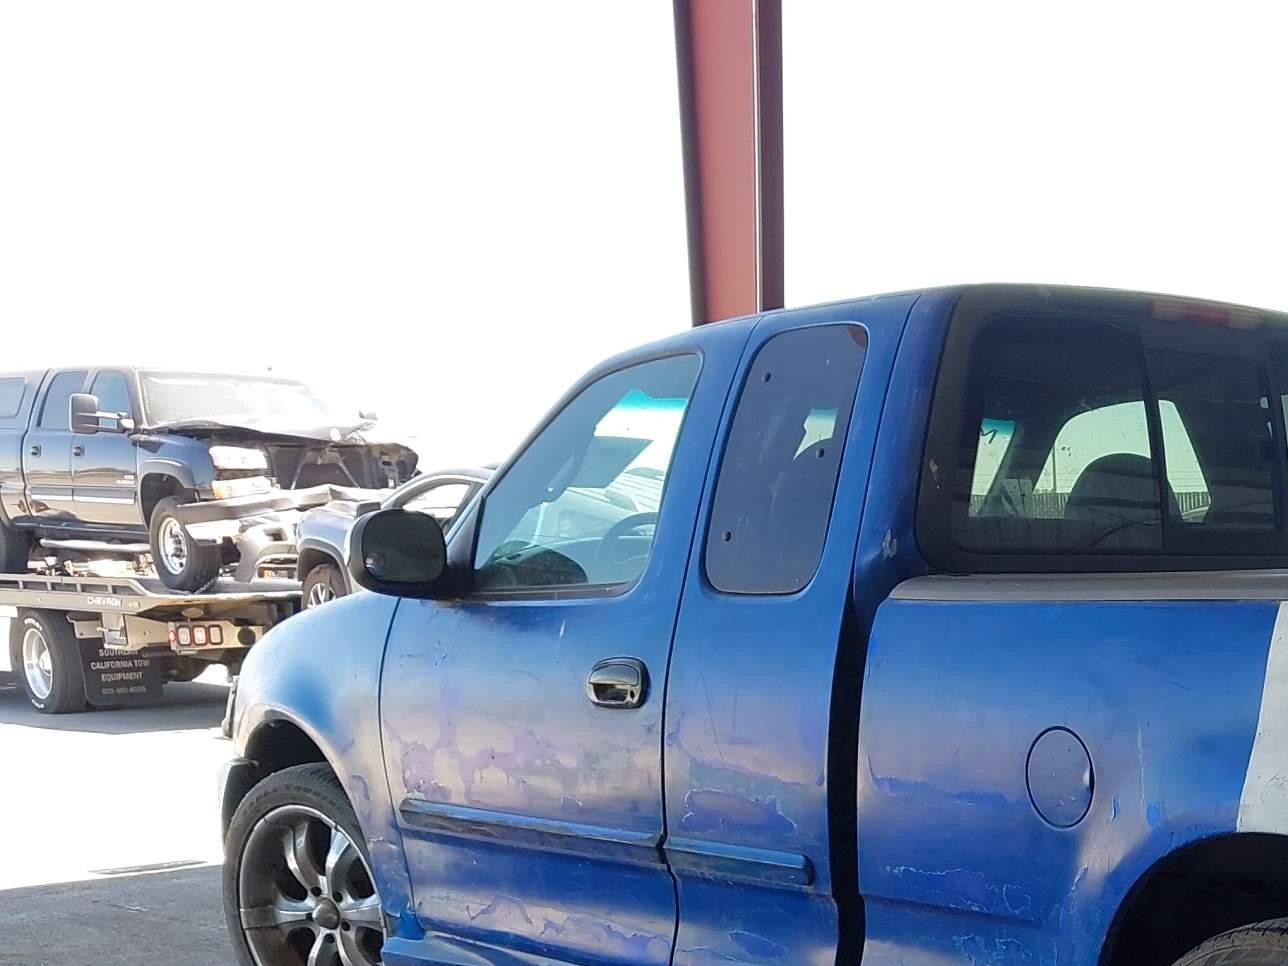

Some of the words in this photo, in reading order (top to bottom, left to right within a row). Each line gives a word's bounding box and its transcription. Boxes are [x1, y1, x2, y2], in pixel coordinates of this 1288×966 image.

[87, 596, 122, 608] CHEVRON
[90, 660, 133, 670] CALIFORNIA
[133, 659, 150, 668] TOW
[101, 671, 143, 682] EQUIPMENT
